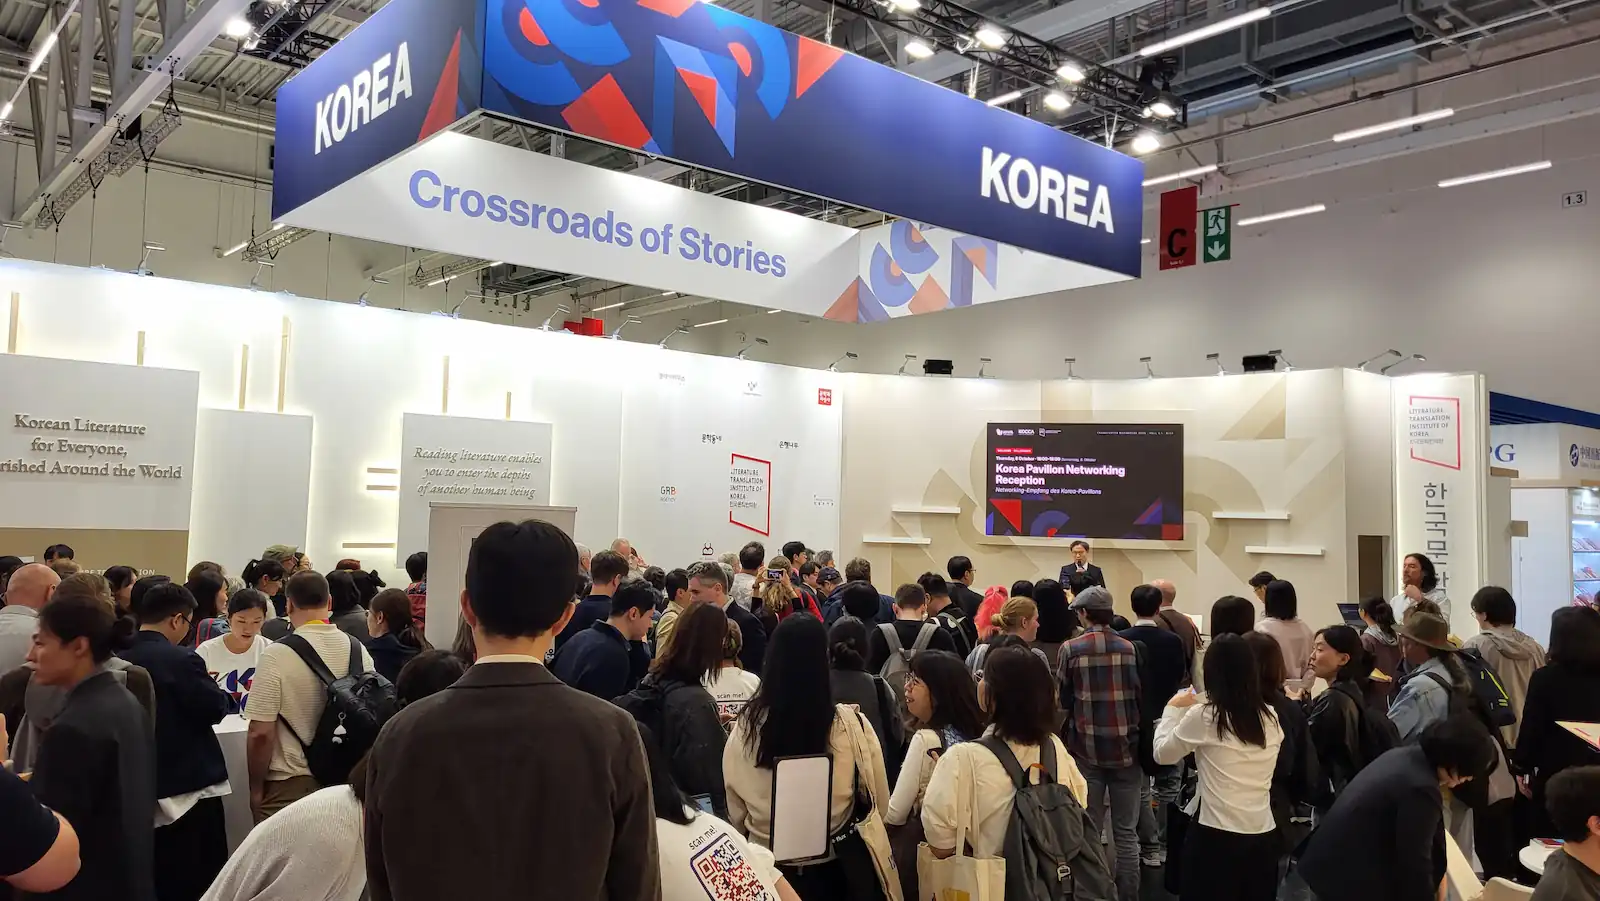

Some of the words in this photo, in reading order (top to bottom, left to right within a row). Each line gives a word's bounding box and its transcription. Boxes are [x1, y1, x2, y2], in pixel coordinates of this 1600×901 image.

[314, 41, 413, 154] KOREA
[980, 146, 1115, 234] KOREA
[1565, 194, 1583, 206] 1.3
[409, 169, 633, 247] Crossroads
[640, 223, 673, 256] of
[679, 227, 787, 277] Stories
[1167, 228, 1188, 258] C
[14, 413, 70, 432] Korean
[74, 418, 146, 436] Literature
[1409, 422, 1440, 430] INSTITUTE
[30, 437, 54, 452] for
[57, 439, 128, 459] Everyone,
[413, 447, 458, 464] Reading
[459, 449, 507, 462] literature
[508, 452, 543, 465] enables
[49, 460, 109, 477] Around
[113, 463, 136, 478] the
[139, 463, 182, 480] World
[422, 467, 443, 480] you
[444, 467, 455, 478] to
[456, 469, 483, 479] enter
[484, 467, 498, 479] the
[500, 468, 531, 483] depths
[730, 468, 759, 476] LITERATURE
[995, 463, 1025, 474] Korea
[1026, 464, 1064, 475] Pavilion
[1065, 465, 1125, 478] Networking
[730, 476, 764, 485] TRANSLATION
[995, 475, 1045, 487] Reception
[417, 481, 431, 497] of
[430, 484, 470, 496] another
[472, 484, 507, 496] human
[509, 485, 536, 500] being
[660, 486, 677, 495] GRB
[995, 486, 1049, 495] Networking-Empfang
[688, 835, 706, 850] scan
[704, 824, 718, 839] me!
